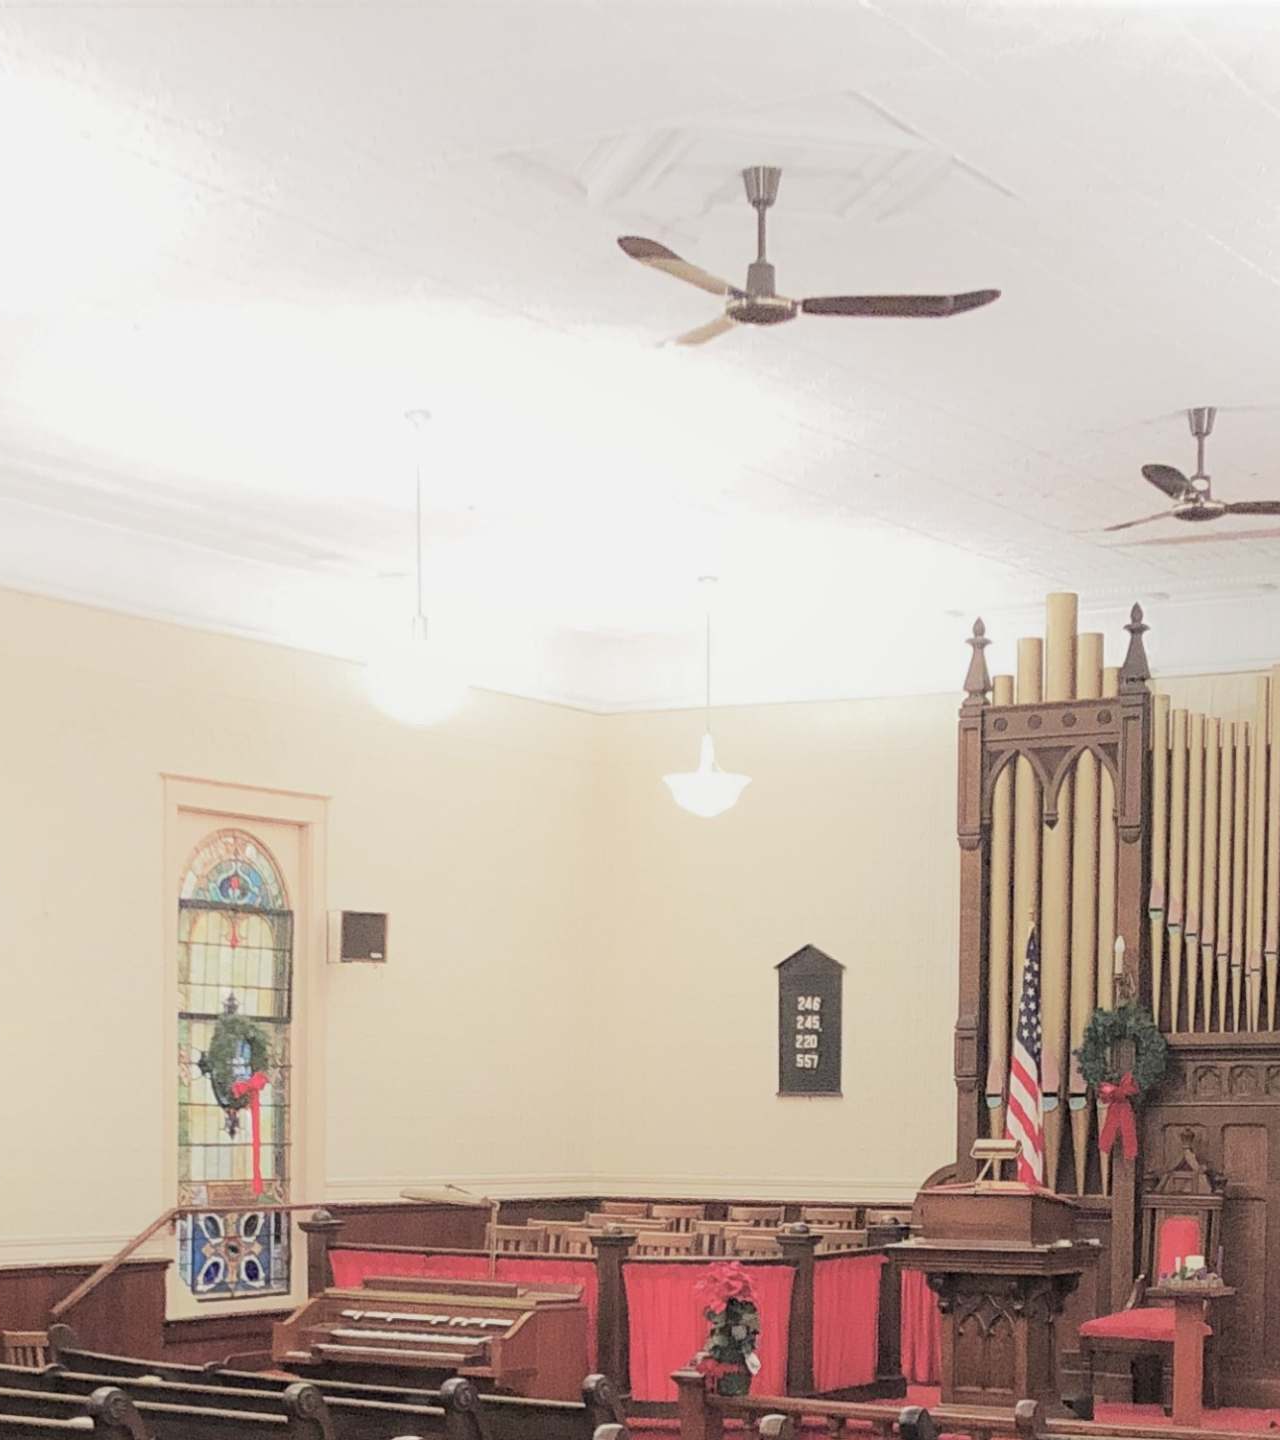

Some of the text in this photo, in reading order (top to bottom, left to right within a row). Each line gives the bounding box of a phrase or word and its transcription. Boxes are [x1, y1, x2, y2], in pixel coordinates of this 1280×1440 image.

[797, 995, 822, 1011] 246
[796, 1015, 820, 1030] 245
[795, 1034, 818, 1049] 220
[795, 1054, 819, 1069] 557
